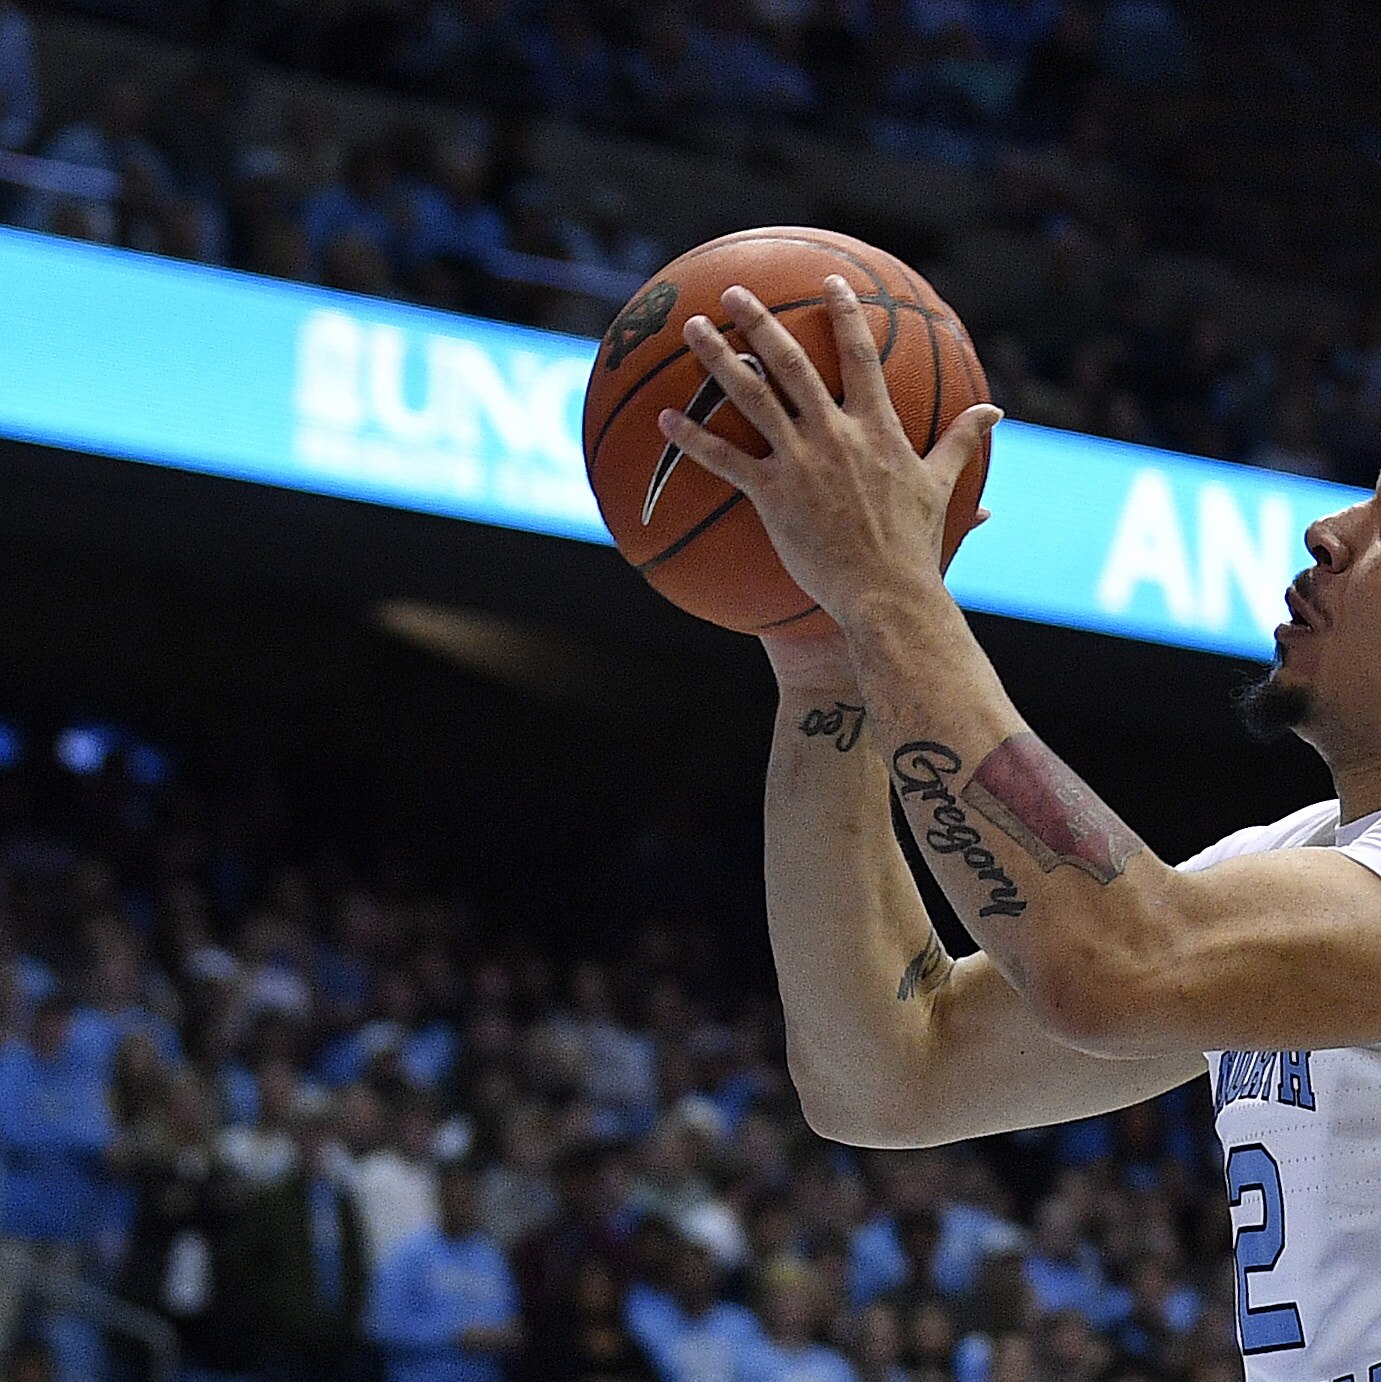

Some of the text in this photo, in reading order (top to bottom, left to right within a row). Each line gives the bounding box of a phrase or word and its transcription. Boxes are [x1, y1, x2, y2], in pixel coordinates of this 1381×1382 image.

[1096, 467, 1294, 637] AN
[892, 741, 1028, 918] Gregory
[1226, 1142, 1306, 1356] 2
